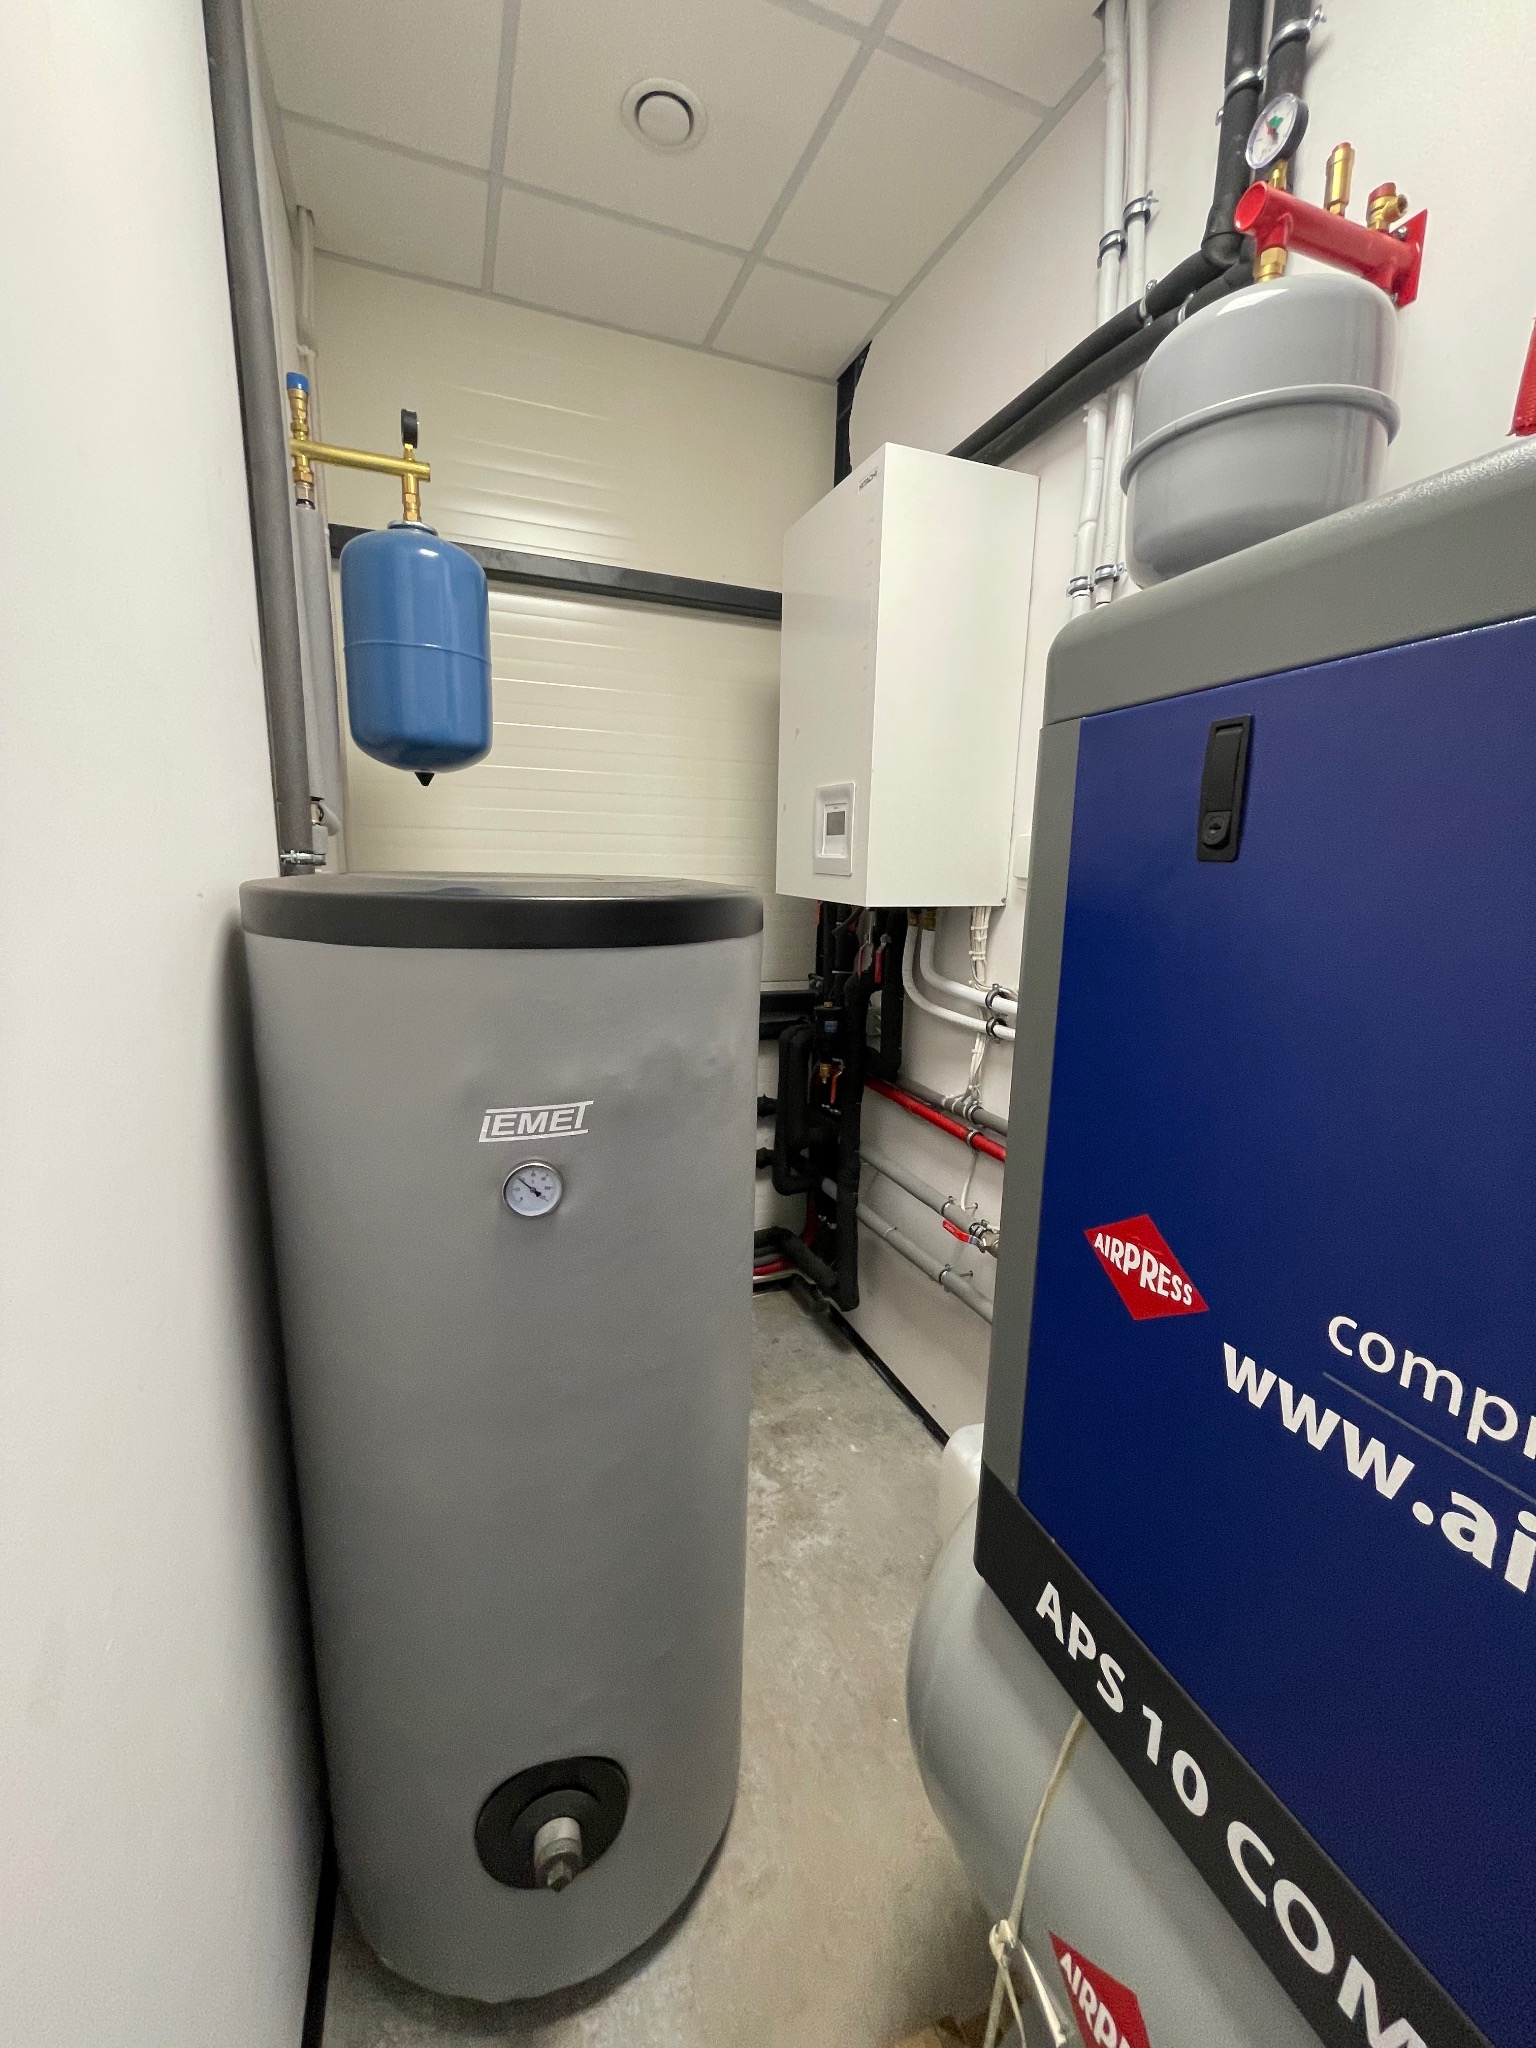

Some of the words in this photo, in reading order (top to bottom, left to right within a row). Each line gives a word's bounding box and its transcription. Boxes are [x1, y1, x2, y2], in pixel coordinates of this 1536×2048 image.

[479, 1100, 594, 1142] LEMET
[1094, 1232, 1193, 1306] AIRPRESS
[1036, 1581, 1125, 1713] APS
[1142, 1704, 1209, 1817] 10
[1060, 1952, 1131, 2048] AIRP
